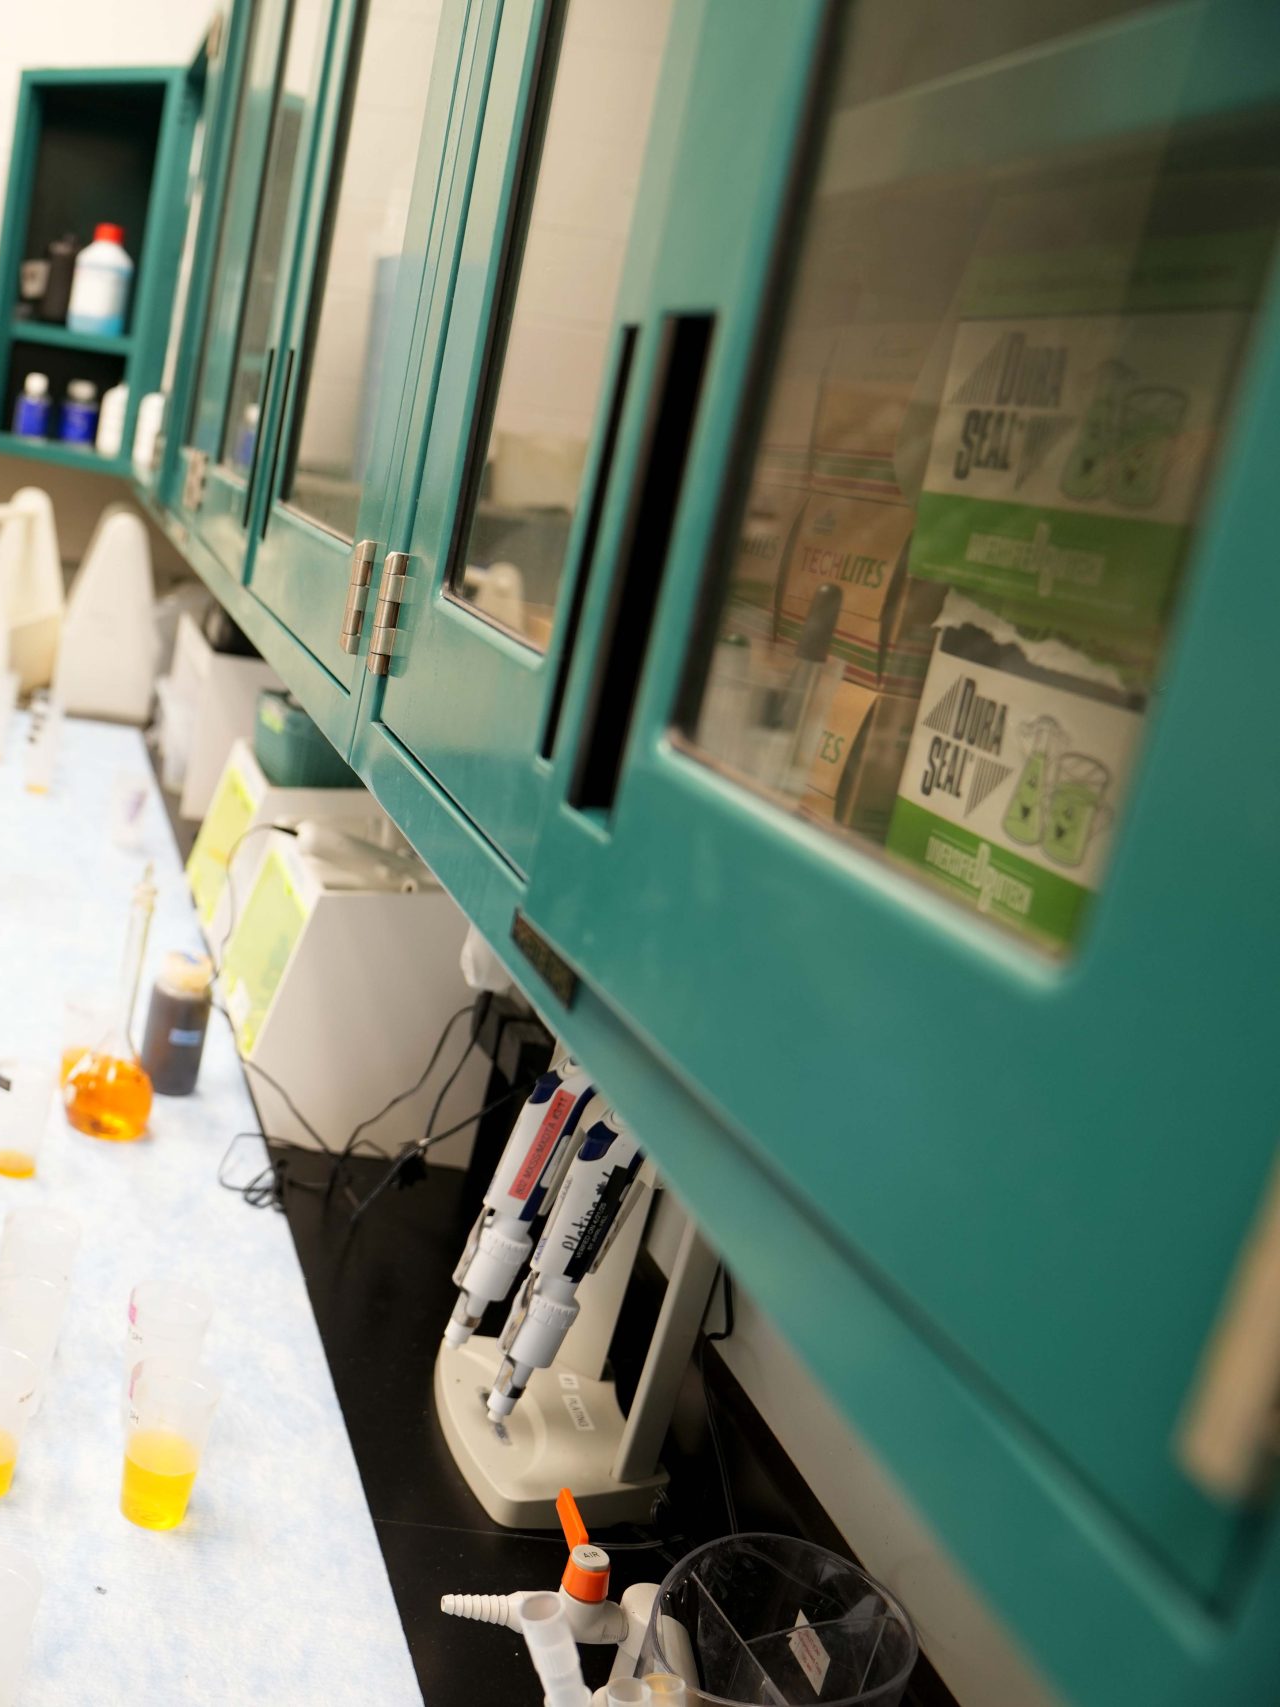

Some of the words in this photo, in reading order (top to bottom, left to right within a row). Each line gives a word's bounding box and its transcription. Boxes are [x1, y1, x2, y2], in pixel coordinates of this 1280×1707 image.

[997, 332, 1067, 408] DURA
[800, 546, 888, 589] TECHLITES
[952, 677, 1007, 757] DURA
[921, 736, 966, 797] SEAL
[583, 1551, 600, 1559] AIR
